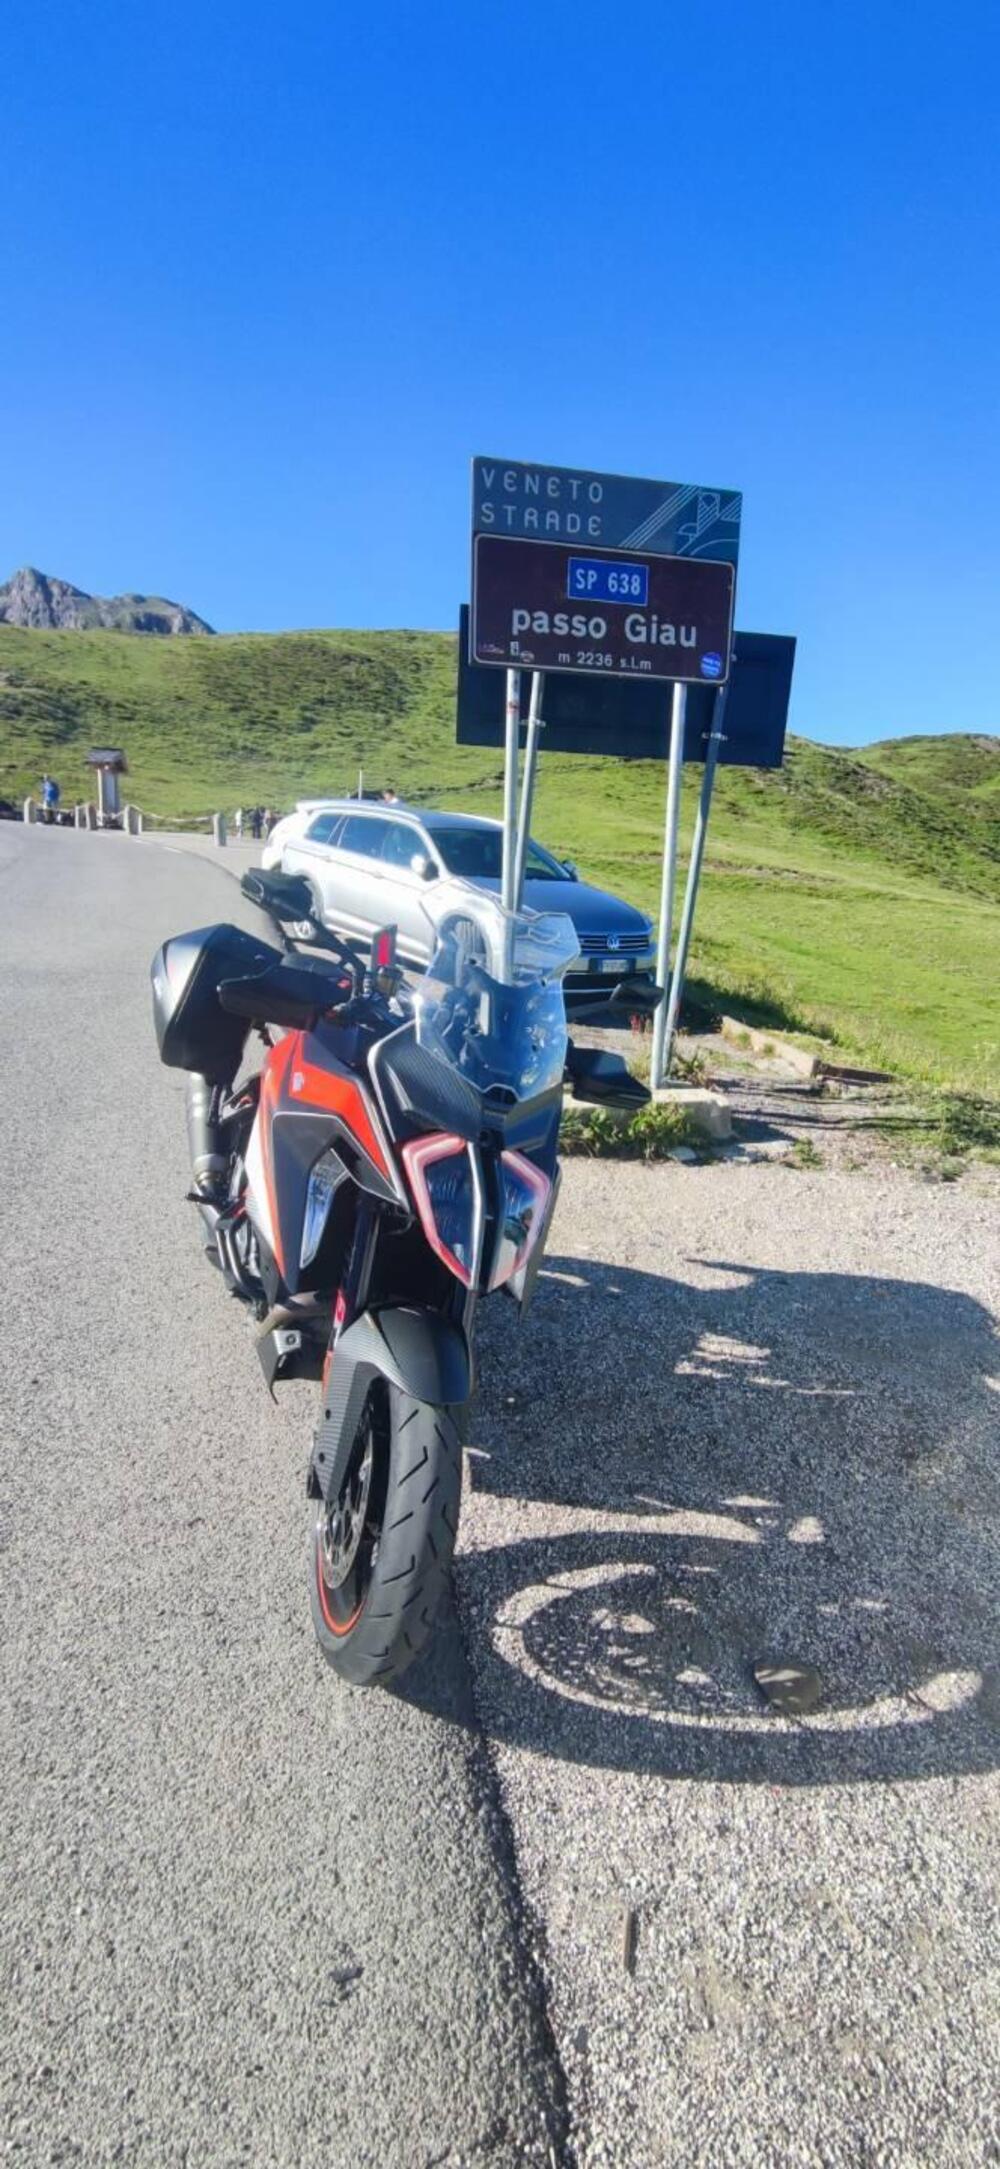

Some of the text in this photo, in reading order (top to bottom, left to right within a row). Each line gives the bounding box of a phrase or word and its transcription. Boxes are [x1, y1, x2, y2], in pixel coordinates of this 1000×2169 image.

[481, 467, 603, 503] VENETO
[481, 503, 602, 536] STRADE
[575, 568, 641, 597] SP 638
[511, 608, 697, 648] passo Giau
[558, 653, 570, 664] m
[576, 651, 613, 668] 2236
